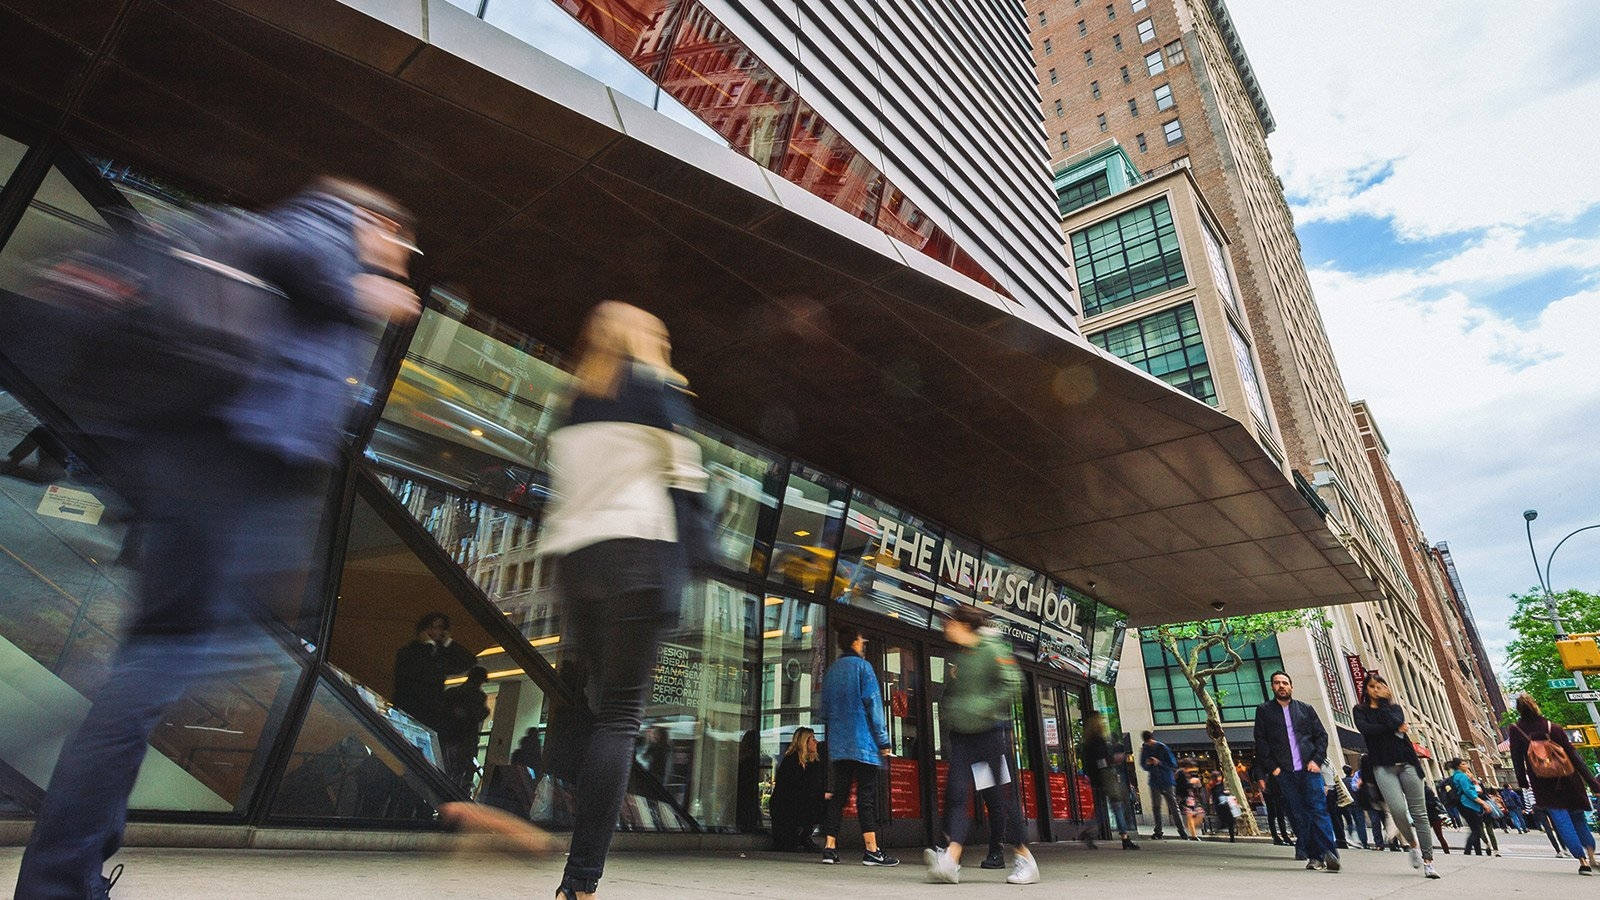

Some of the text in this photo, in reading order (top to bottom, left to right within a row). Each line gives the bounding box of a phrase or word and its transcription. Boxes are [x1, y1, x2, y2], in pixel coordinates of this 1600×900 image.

[878, 516, 1082, 633] THE NEW SCHOOL
[1011, 627, 1035, 643] CENTER
[656, 646, 689, 660] DESIGN
[655, 654, 689, 667] LIBERAL
[1350, 657, 1362, 679] MERCI
[654, 675, 684, 687] MEDIA
[652, 693, 685, 706] SOCIAL
